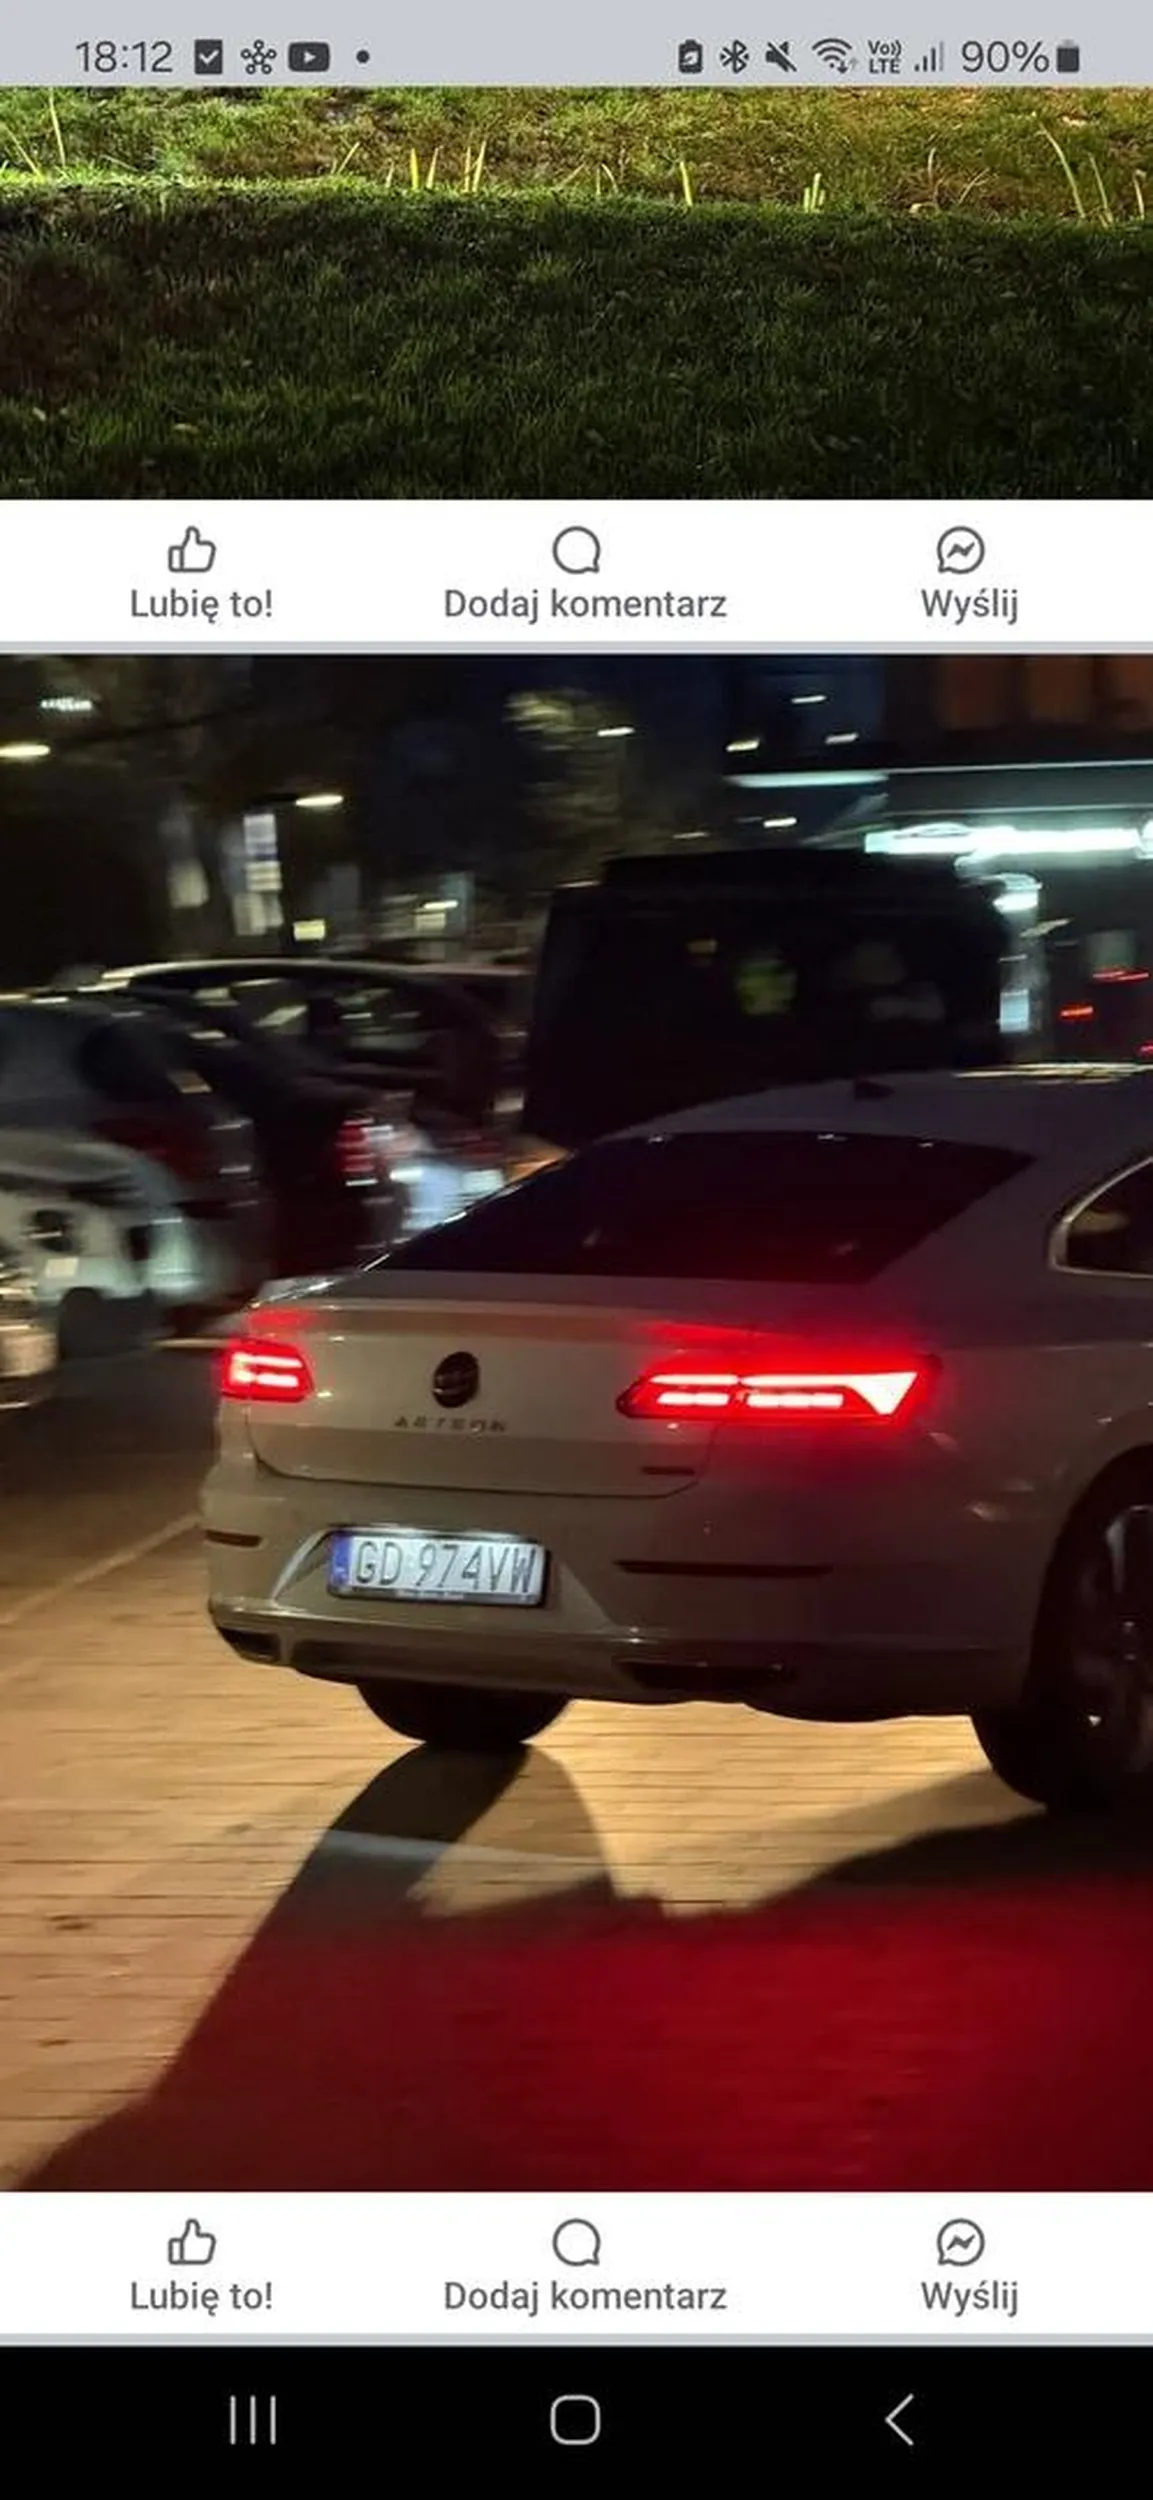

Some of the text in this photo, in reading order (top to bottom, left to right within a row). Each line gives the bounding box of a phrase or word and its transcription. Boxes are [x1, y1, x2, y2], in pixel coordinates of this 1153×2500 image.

[76, 40, 173, 72] 18:12
[868, 58, 901, 74] LTE
[961, 40, 1050, 73] 90%
[130, 588, 273, 625] Lubię to!
[444, 588, 728, 626] Dodaj komentarz
[920, 588, 1018, 626] Wyślij
[355, 1541, 537, 1594] GD 974VW
[130, 2280, 273, 2317] Lubię to!
[444, 2280, 728, 2318] Dodaj komentarz
[920, 2280, 1018, 2318] Wyślij
